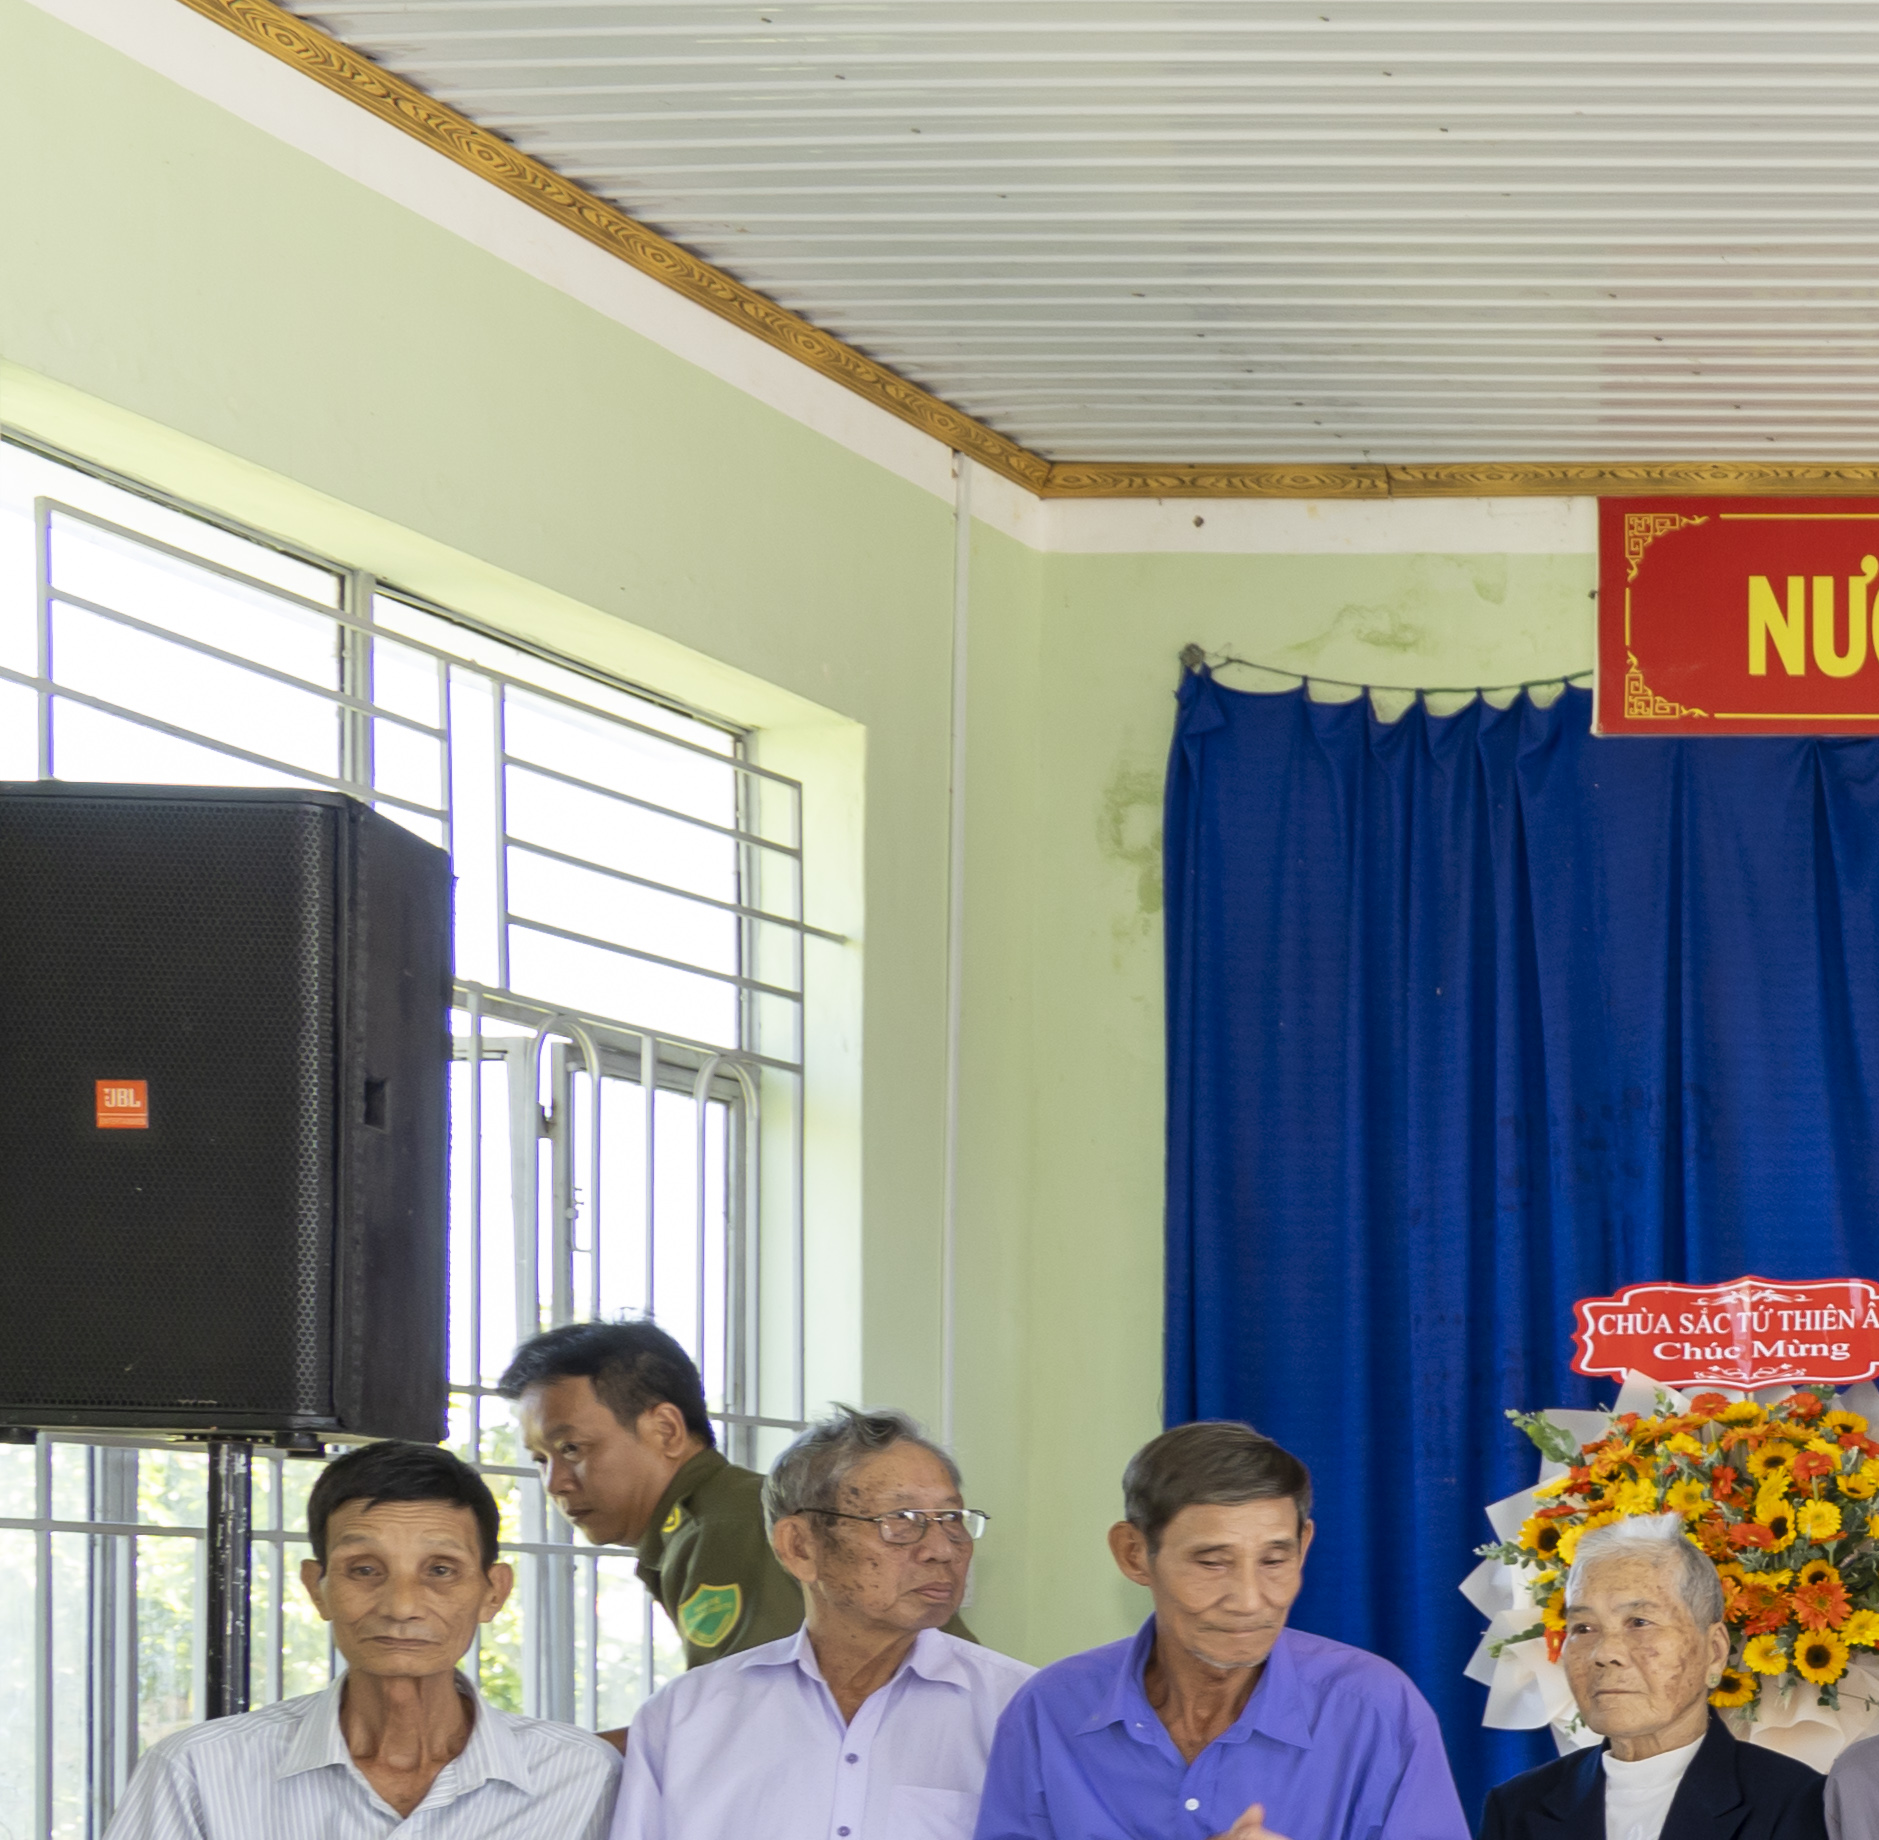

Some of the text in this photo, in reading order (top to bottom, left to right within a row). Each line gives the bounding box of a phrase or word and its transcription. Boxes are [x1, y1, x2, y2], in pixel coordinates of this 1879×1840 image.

[103, 1088, 141, 1108] JBL
[1598, 1305, 1673, 1335] CHÙA
[1679, 1306, 1730, 1336] SẮC
[1778, 1304, 1856, 1330] THIÊN
[1653, 1339, 1850, 1361] Chúc Mừng
